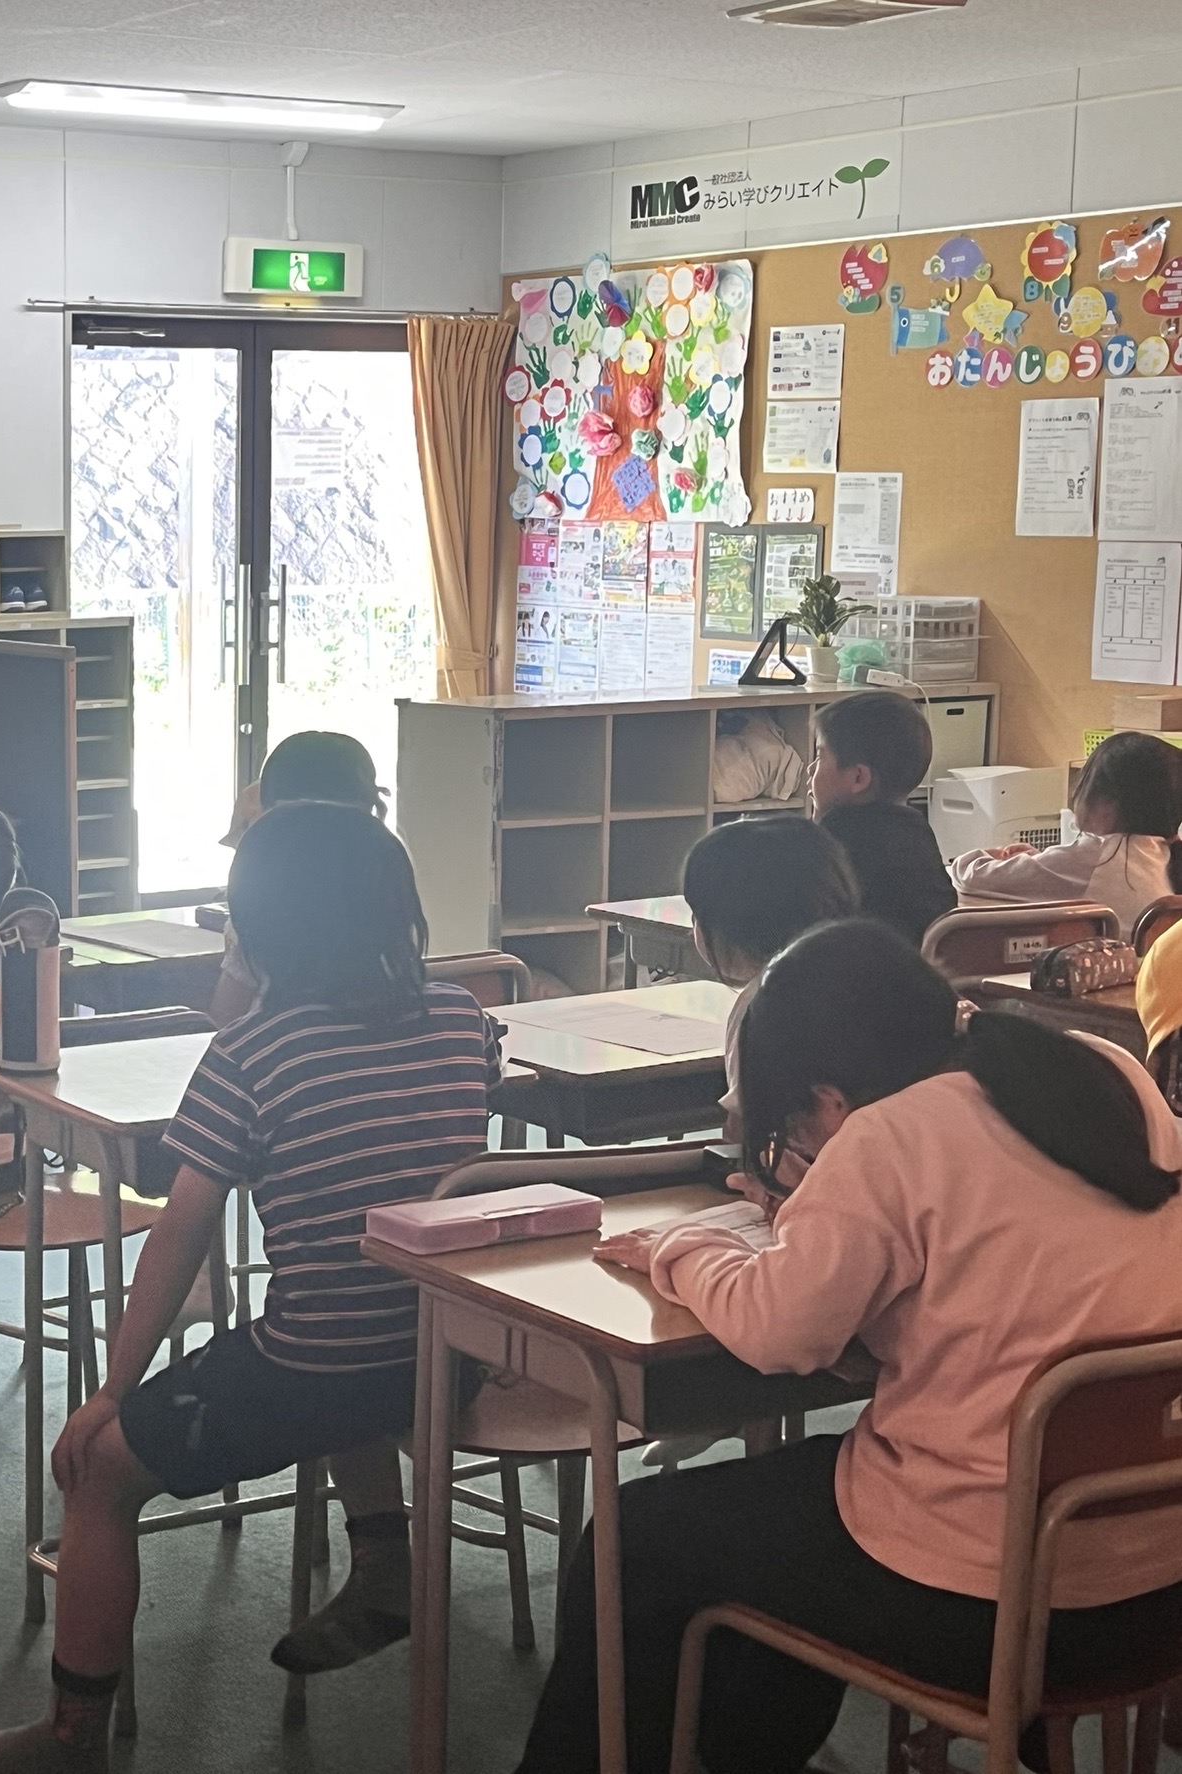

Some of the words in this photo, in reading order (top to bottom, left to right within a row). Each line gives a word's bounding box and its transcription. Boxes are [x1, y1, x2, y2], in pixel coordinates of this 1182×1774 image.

[631, 176, 700, 219] MMC
[703, 178, 839, 211] みらい学びクリエイト
[630, 220, 649, 230] Mirai
[677, 214, 701, 225] Create
[890, 285, 902, 303] 5
